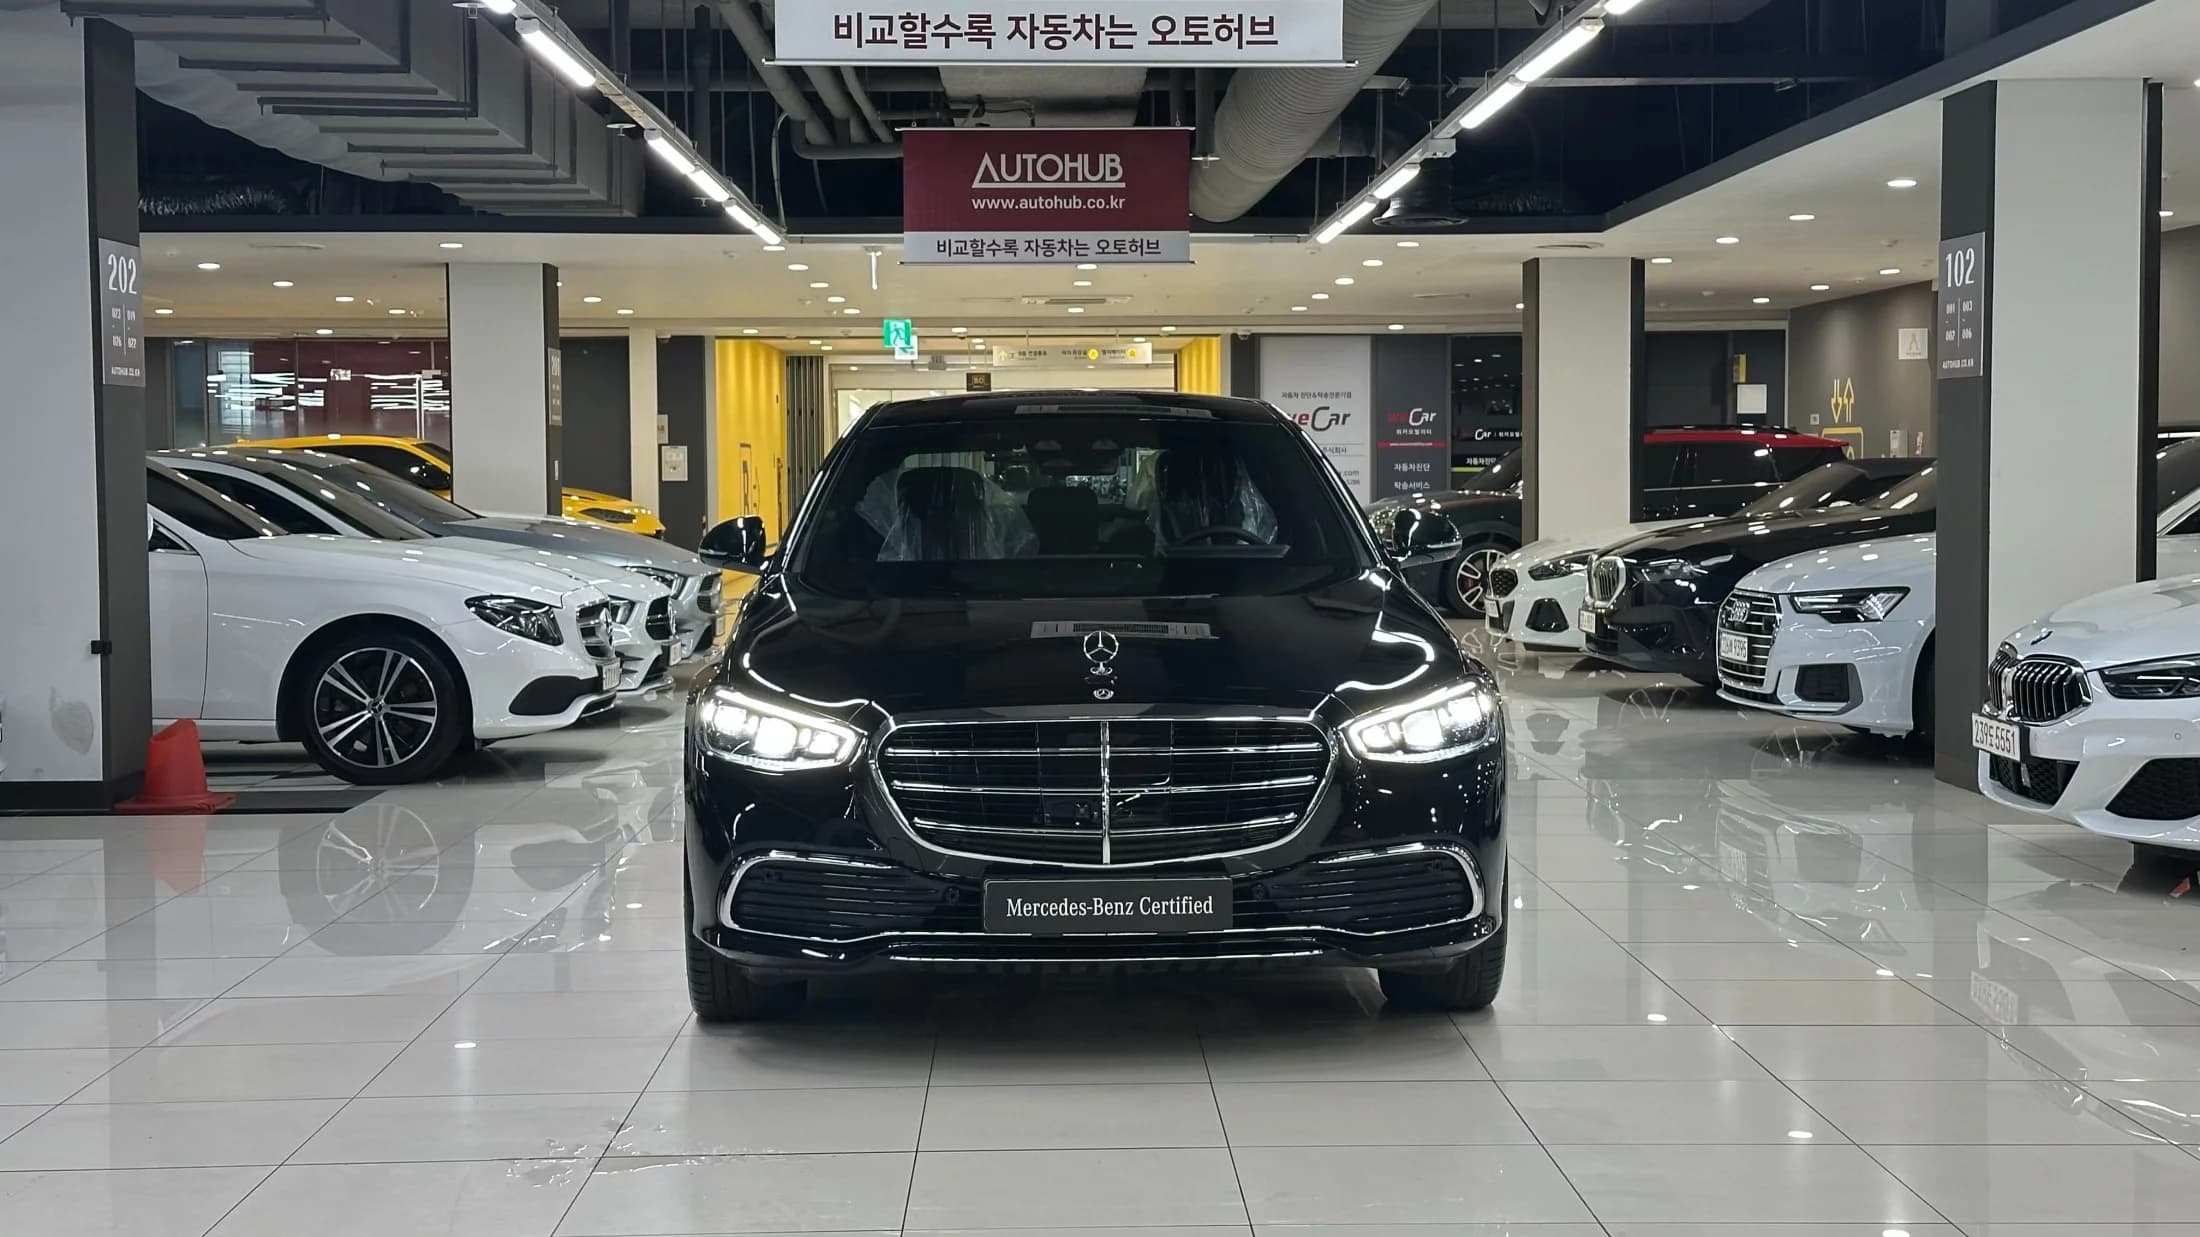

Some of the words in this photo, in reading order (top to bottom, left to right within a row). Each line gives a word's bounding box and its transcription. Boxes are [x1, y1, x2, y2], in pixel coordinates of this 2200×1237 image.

[834, 13, 996, 50] 비교할수록
[1006, 13, 1138, 51] 자동차는
[1147, 13, 1279, 50] 오토허브
[971, 152, 1126, 188] AUTOHUB
[971, 195, 1126, 209] www.autohub.co.kr
[936, 238, 1019, 257] 비교할수록
[1024, 238, 1090, 257] 자동차는
[1095, 238, 1161, 257] 오토허브
[107, 253, 137, 295] 202
[1945, 247, 1976, 288] 102
[1006, 897, 1134, 917] Mercedes-Benz
[1139, 896, 1214, 916] Certified
